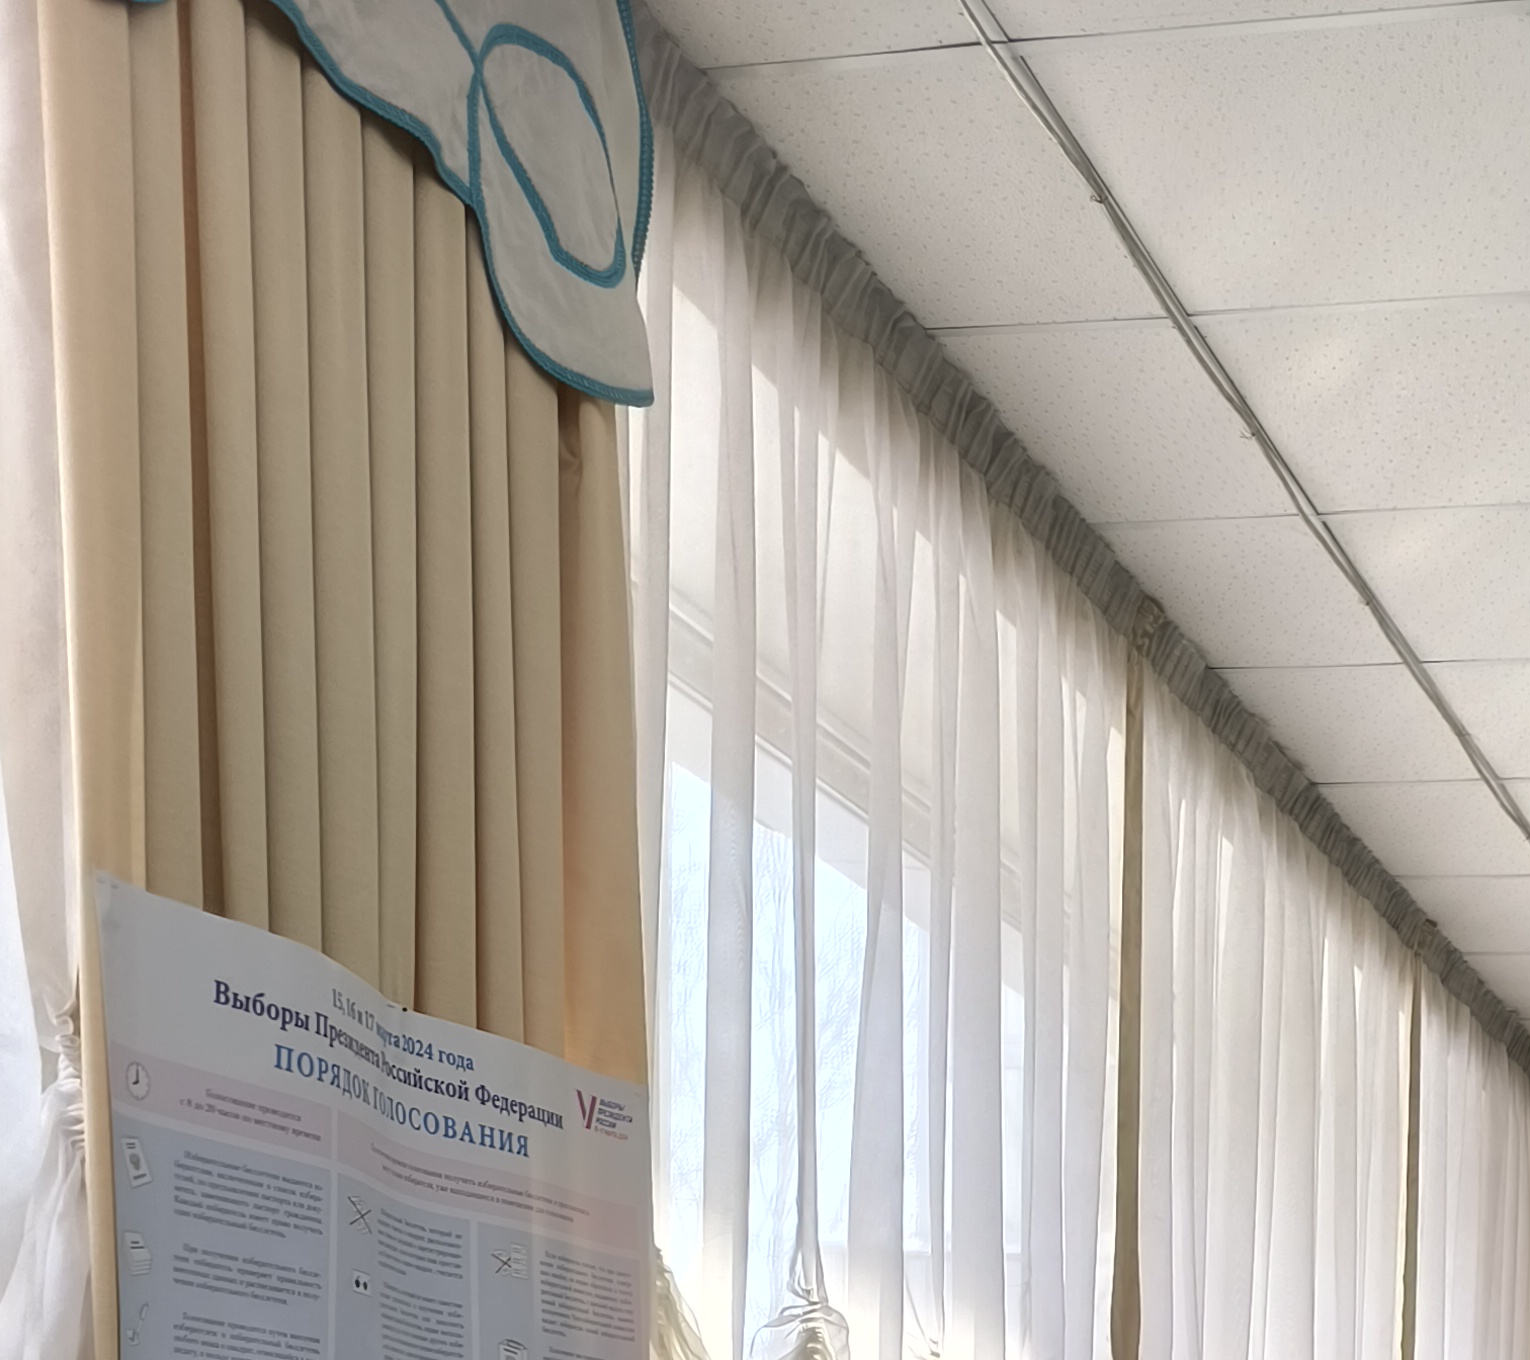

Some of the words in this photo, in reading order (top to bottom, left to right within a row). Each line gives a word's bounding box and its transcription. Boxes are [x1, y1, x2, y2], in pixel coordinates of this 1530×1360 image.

[213, 979, 310, 1032] Выборы
[314, 1011, 380, 1069] Президента
[380, 1050, 470, 1101] Российской
[474, 1084, 564, 1129] Федерации
[346, 997, 356, 1019] 16
[365, 1010, 375, 1031] 17
[402, 1033, 433, 1060] 2024
[438, 1050, 475, 1072] года
[273, 1043, 370, 1106] ПОРЯДОК
[373, 1086, 530, 1157] ГОЛОСОВАНИЯ
